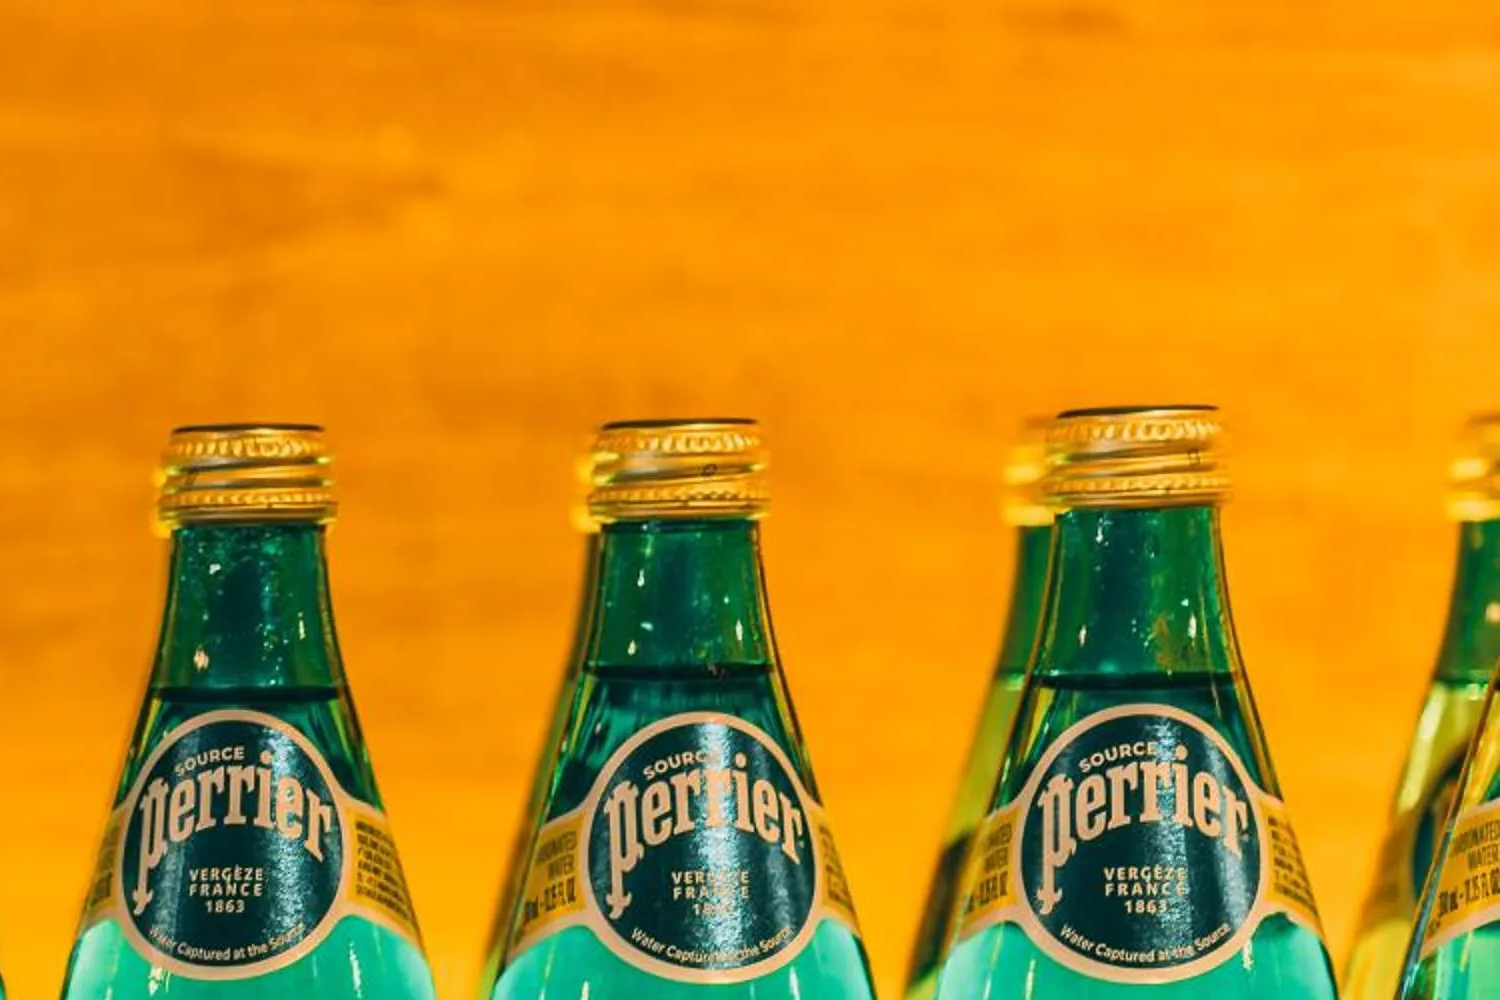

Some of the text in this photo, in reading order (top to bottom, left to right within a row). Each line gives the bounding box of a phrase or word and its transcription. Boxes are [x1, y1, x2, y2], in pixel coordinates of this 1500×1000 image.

[174, 745, 245, 776] SOURCE
[643, 750, 719, 779] SOURC
[1078, 741, 1158, 773] SOURCE
[189, 863, 264, 882] VERGÈZE
[671, 868, 749, 885] VERE
[189, 882, 263, 898] FRANCE
[673, 885, 749, 900] FRAE
[1104, 881, 1187, 897] FRANCE
[205, 899, 245, 914] 1863
[1123, 899, 1168, 914] 1863
[177, 941, 231, 961] Captured
[233, 948, 246, 960] at
[247, 943, 269, 955] the
[631, 927, 666, 953] Water
[666, 944, 724, 963] Captur
[1060, 922, 1231, 963] Water Captured at the Source
